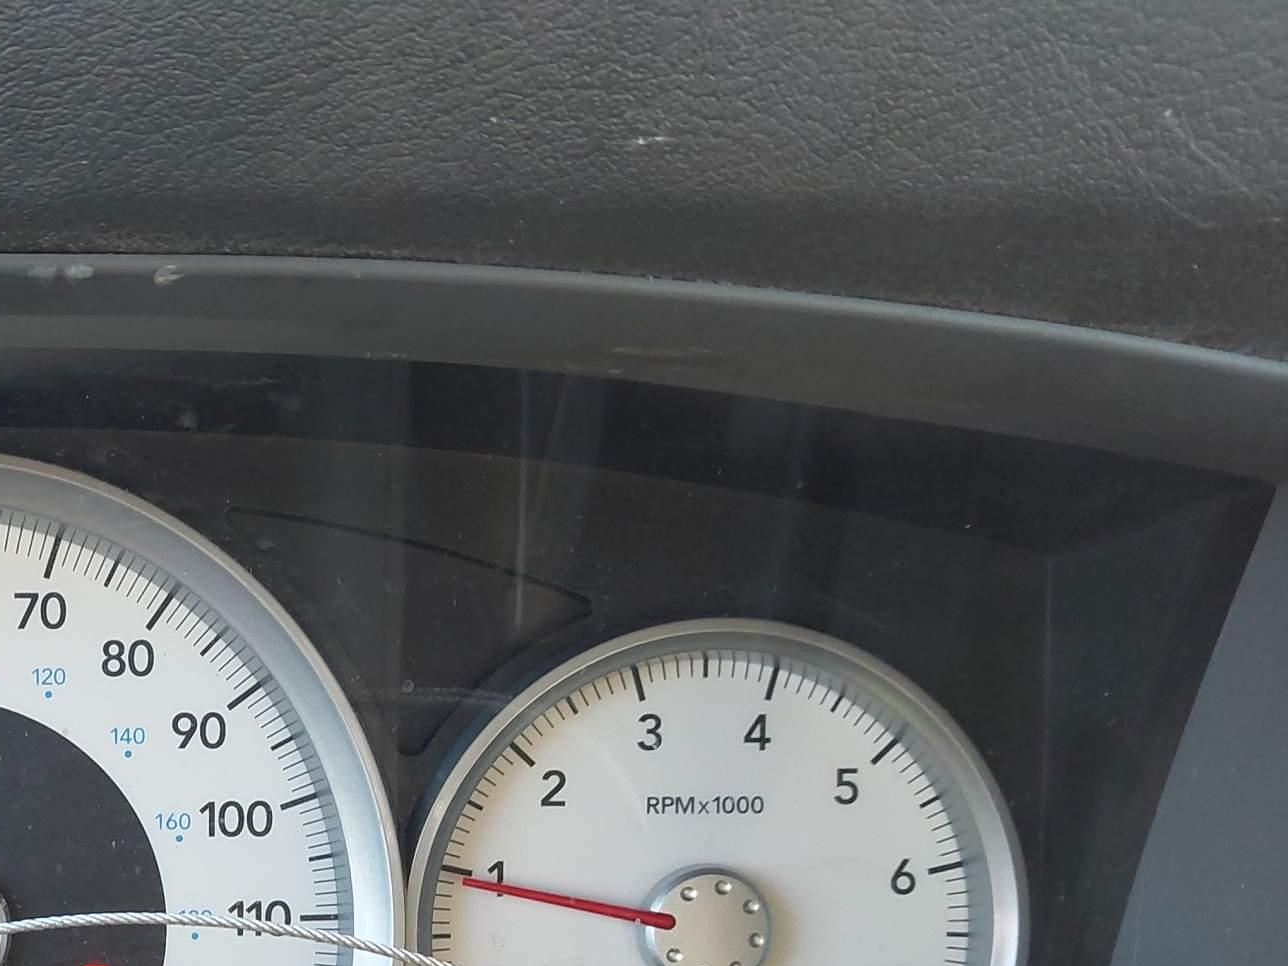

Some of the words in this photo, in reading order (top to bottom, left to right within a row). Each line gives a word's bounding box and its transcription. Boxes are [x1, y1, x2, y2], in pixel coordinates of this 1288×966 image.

[14, 591, 67, 630] 70
[31, 667, 66, 686] 120
[101, 639, 155, 678] 80
[110, 727, 146, 745] 140
[171, 710, 228, 750] 90
[637, 713, 662, 751] 3
[743, 713, 771, 751] 4
[540, 769, 566, 807] 2
[834, 768, 859, 805] 5
[155, 812, 191, 831] 160
[199, 800, 273, 838] 100
[488, 861, 504, 897] 1
[890, 858, 916, 896] 6
